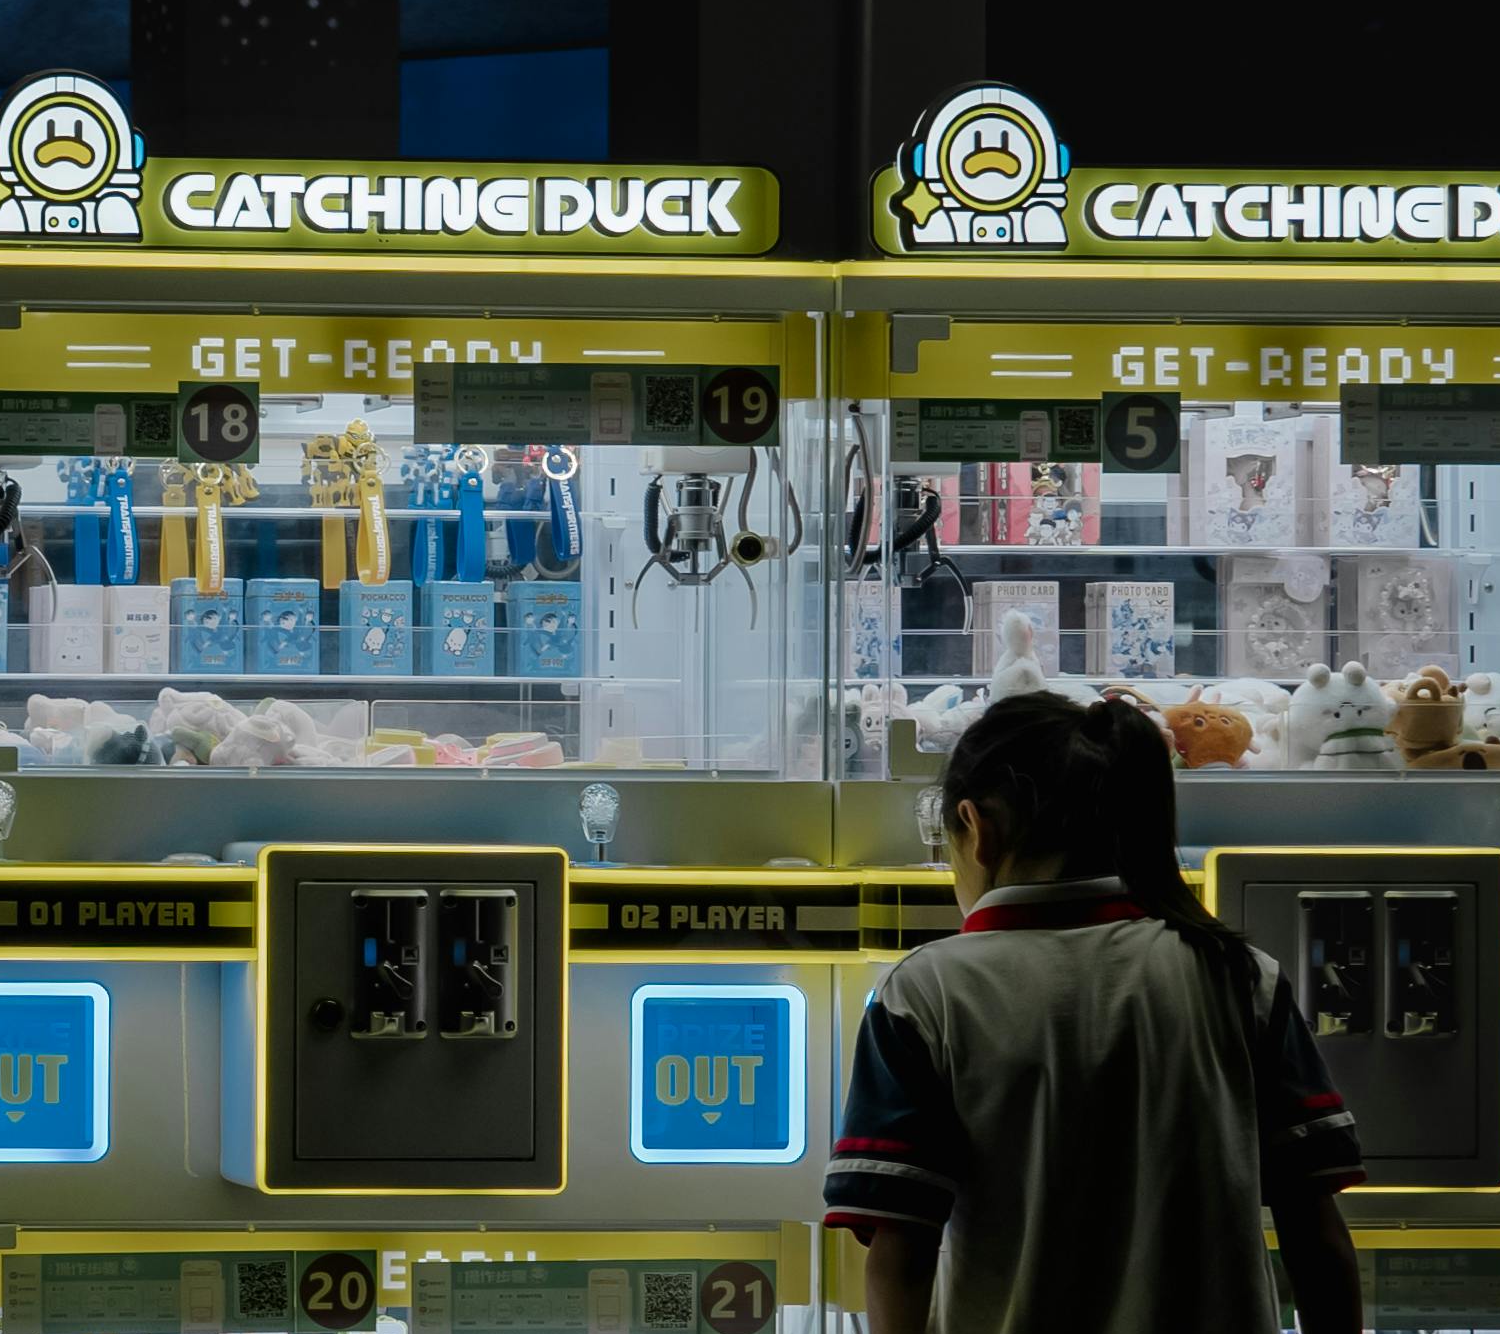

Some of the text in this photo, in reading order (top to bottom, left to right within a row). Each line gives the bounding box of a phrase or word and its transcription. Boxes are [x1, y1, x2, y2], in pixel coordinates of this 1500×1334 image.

[168, 174, 743, 235] CATCHING DUCK
[1091, 184, 1449, 239] CATCHING
[1113, 346, 1455, 387] GET-READY
[190, 402, 249, 443] 18
[710, 386, 769, 426] 19
[1124, 405, 1158, 459] 5
[996, 585, 1056, 597] PHOTO CARD
[1110, 586, 1170, 597] PHOTO CARD
[29, 900, 195, 928] 01 PLAYER
[620, 903, 785, 932] 02 PLAYER
[655, 1055, 764, 1106] OUT
[307, 1270, 369, 1311] 20
[709, 1279, 765, 1319] 21
